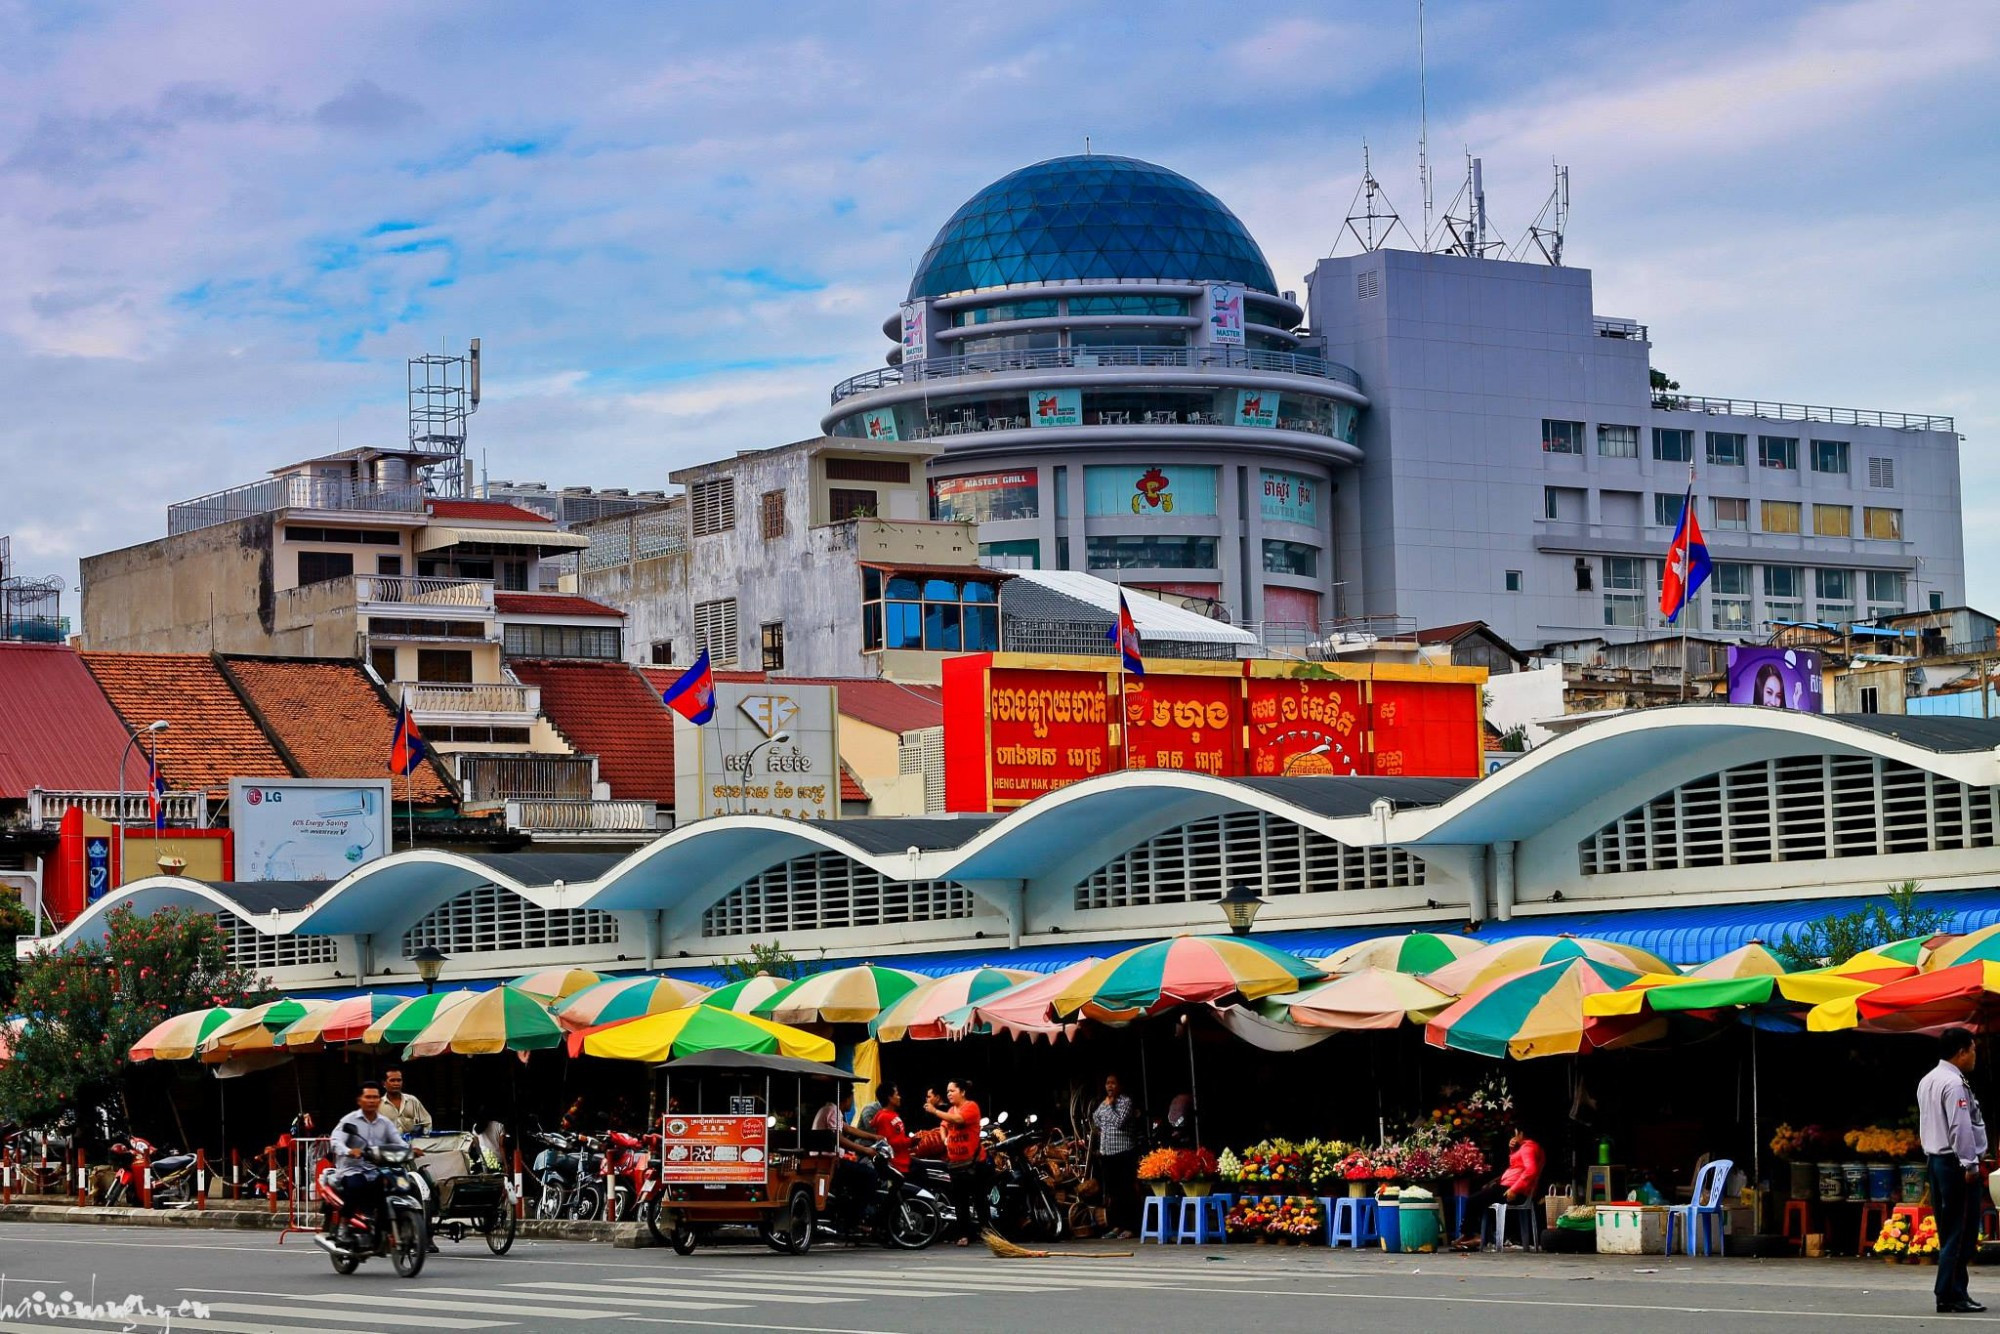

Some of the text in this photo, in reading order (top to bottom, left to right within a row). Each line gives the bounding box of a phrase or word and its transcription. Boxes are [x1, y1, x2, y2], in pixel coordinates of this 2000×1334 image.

[965, 477, 998, 488] MASTER
[1002, 475, 1027, 484] GRILL
[994, 777, 1015, 790] HENG
[1015, 778, 1030, 790] LAY
[1031, 778, 1049, 790] HAK
[265, 791, 282, 803] LG
[305, 819, 325, 828] Energy
[326, 819, 349, 828] Saving
